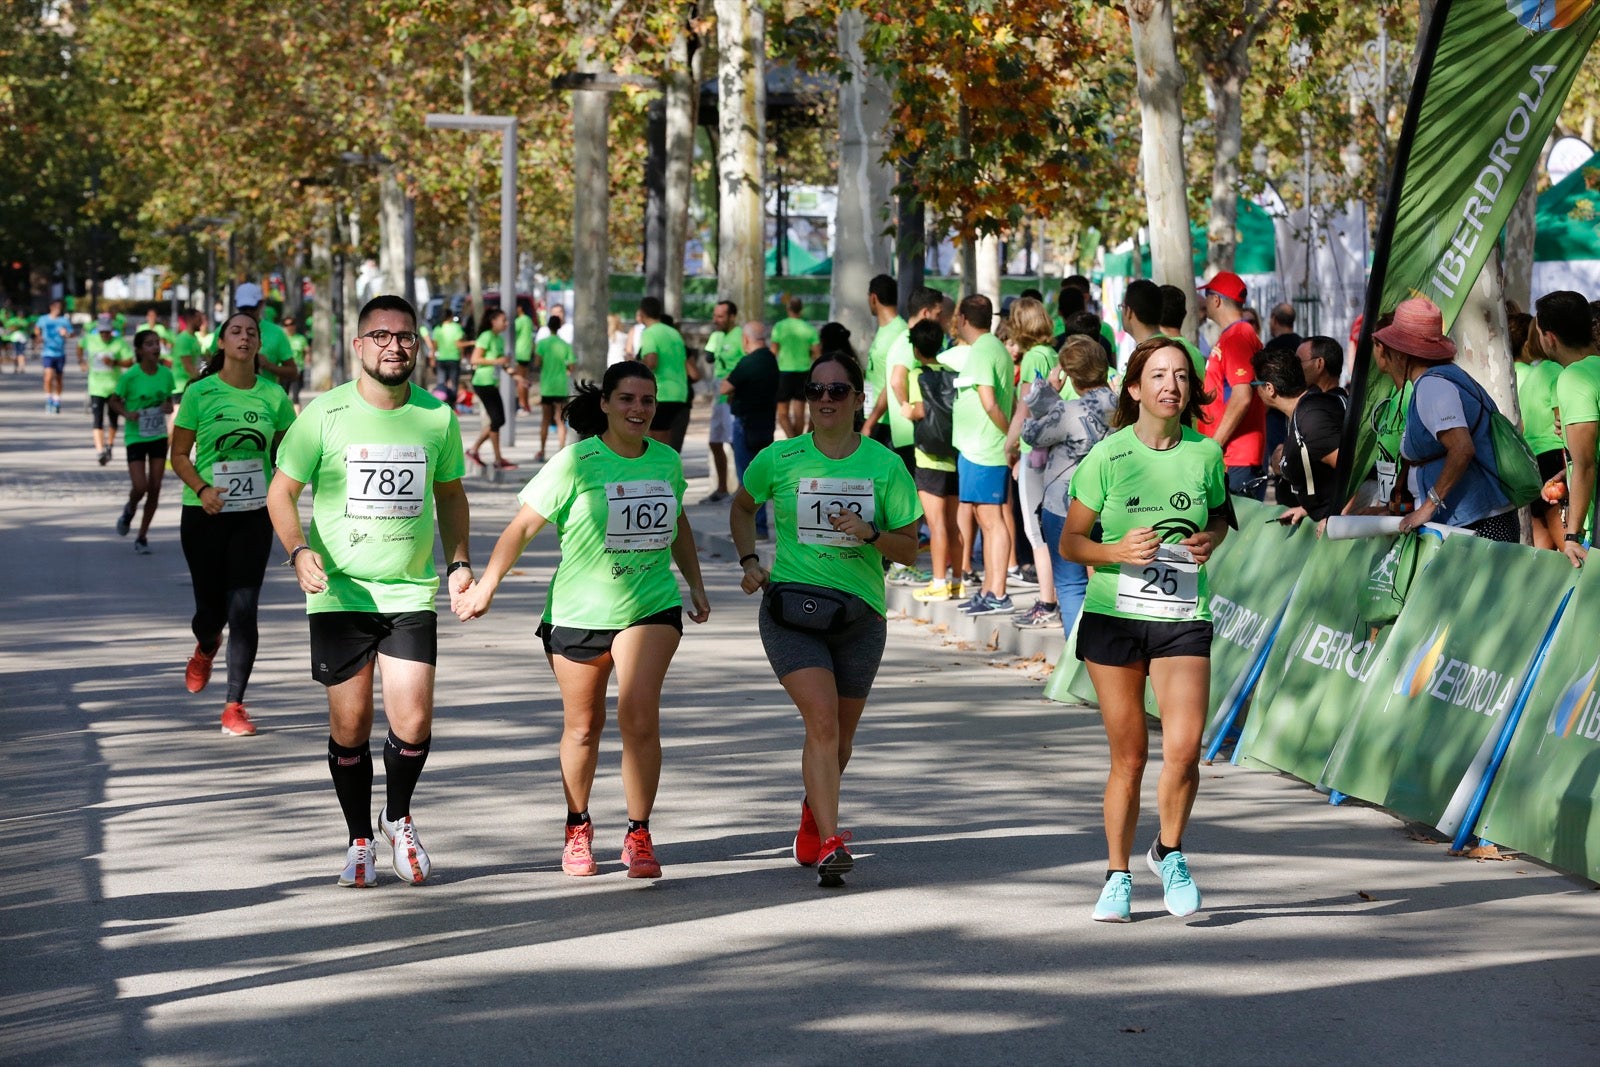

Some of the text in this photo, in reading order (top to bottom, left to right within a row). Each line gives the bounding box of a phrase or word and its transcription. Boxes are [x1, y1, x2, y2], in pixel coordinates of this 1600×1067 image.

[1431, 64, 1557, 299] IBERDROLA
[229, 477, 254, 497] 24
[360, 468, 414, 496] 782
[621, 502, 668, 531] 162
[1127, 506, 1164, 514] IBERDROLA
[1140, 566, 1178, 596] 25
[1209, 594, 1269, 652] ERDROLA
